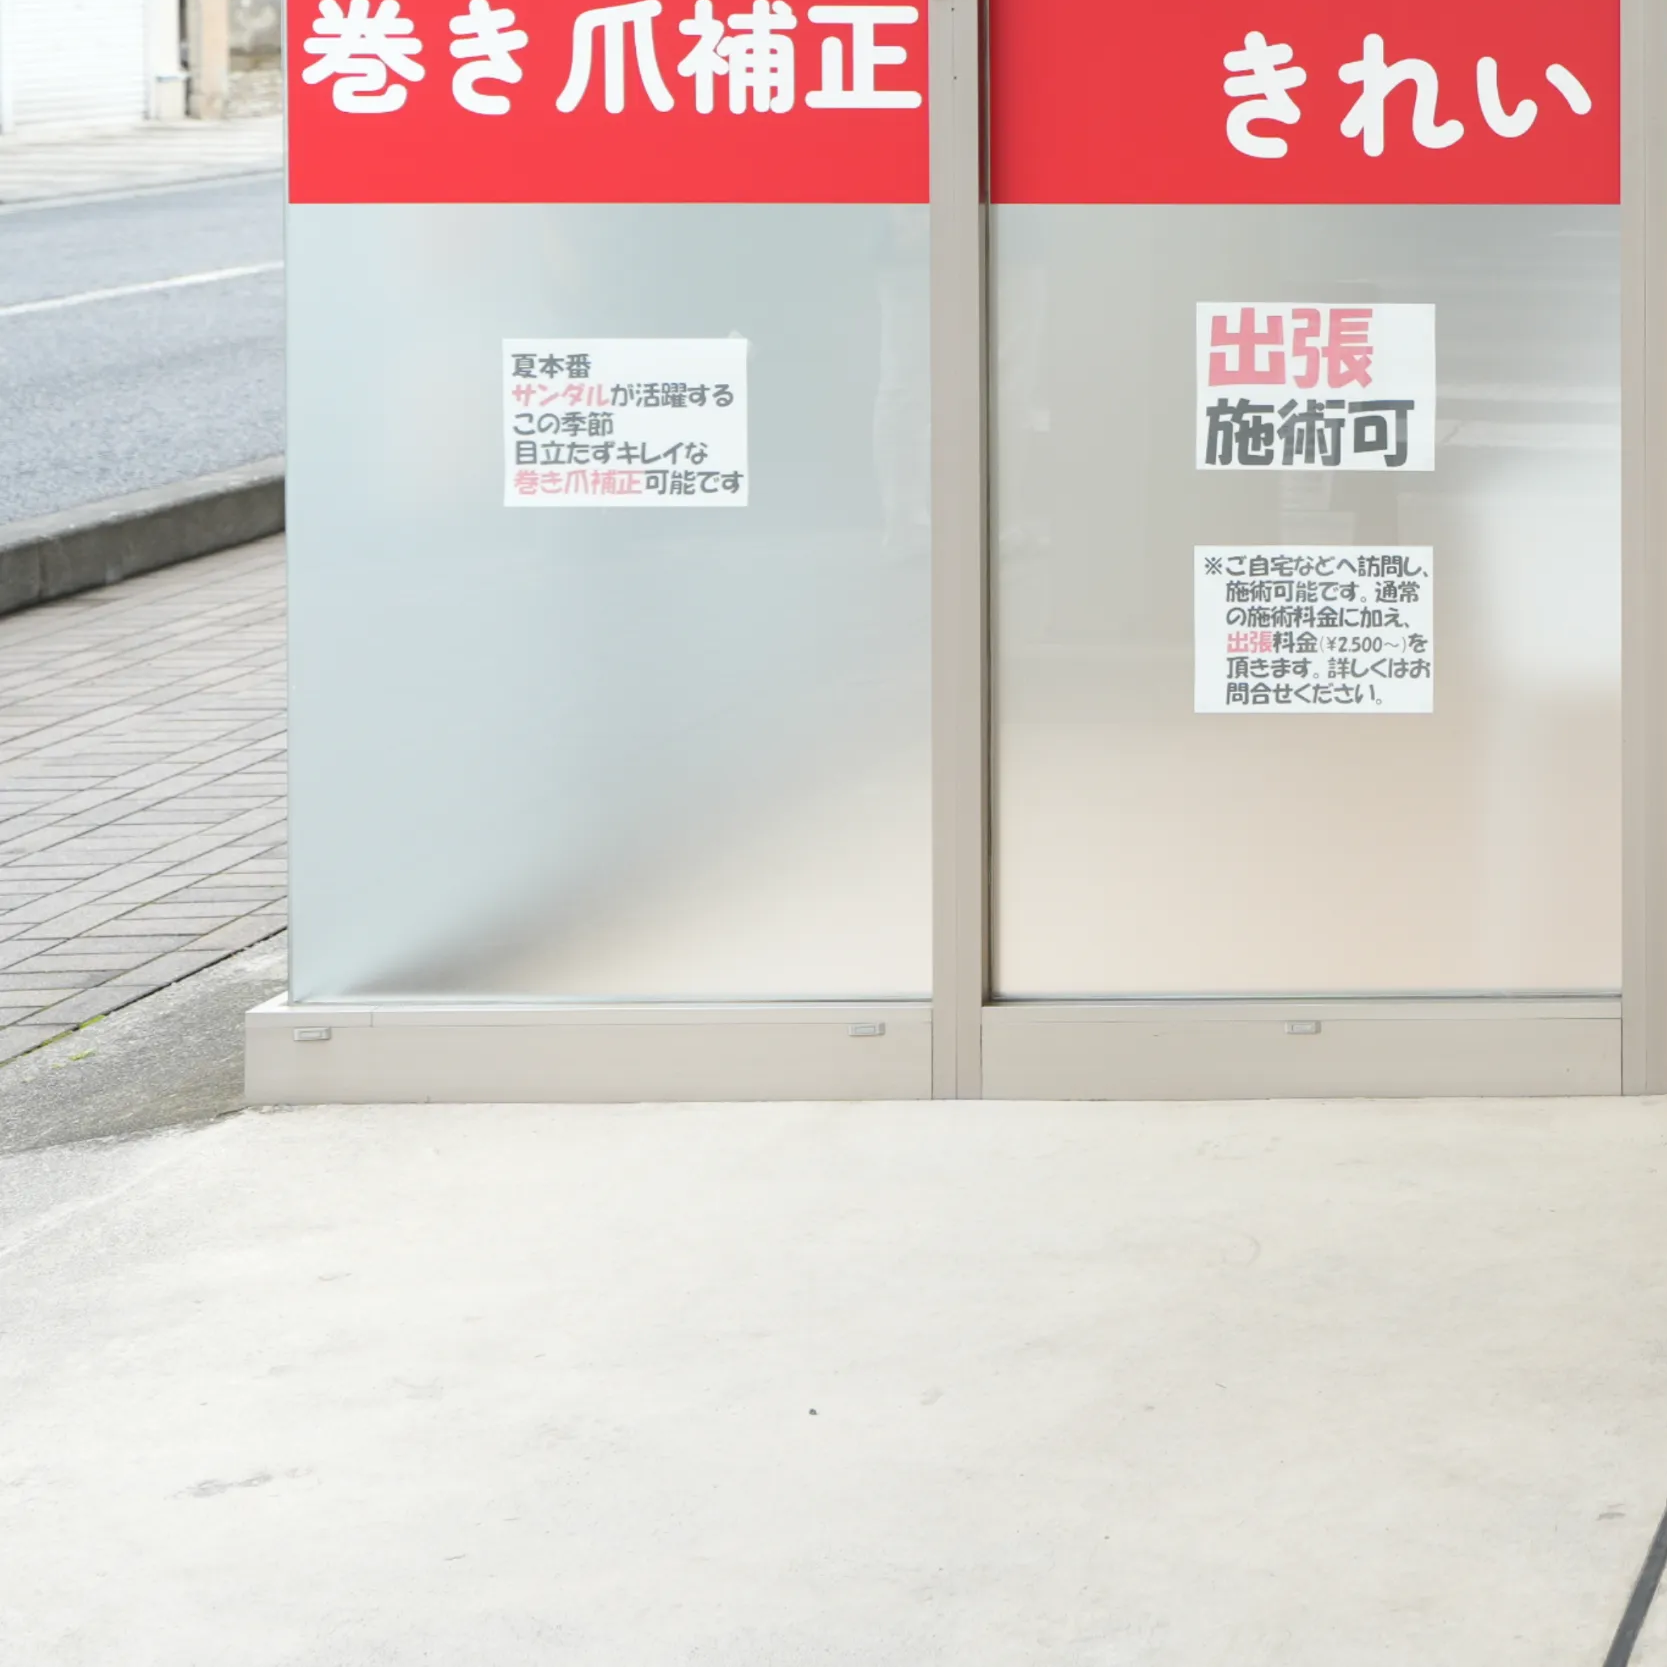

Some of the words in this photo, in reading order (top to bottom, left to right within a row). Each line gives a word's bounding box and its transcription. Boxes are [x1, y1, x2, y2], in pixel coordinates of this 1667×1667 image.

[1222, 30, 1593, 159] きれい
[1208, 307, 1374, 389] 出張
[511, 353, 592, 379] 夏本番
[511, 382, 735, 408] サンダルが活躍する
[512, 411, 614, 437] この季節
[1205, 397, 1416, 468] 施術可
[515, 439, 709, 466] 目立たずキレイな
[514, 469, 744, 495] 巻き爪補正可能です
[1225, 580, 1421, 604] 施術可能です。通常
[1225, 605, 1411, 629] の施術料金に加え、
[1226, 656, 1431, 680] 頂きます。詳しくはお
[1225, 681, 1383, 706] 問合せください。
